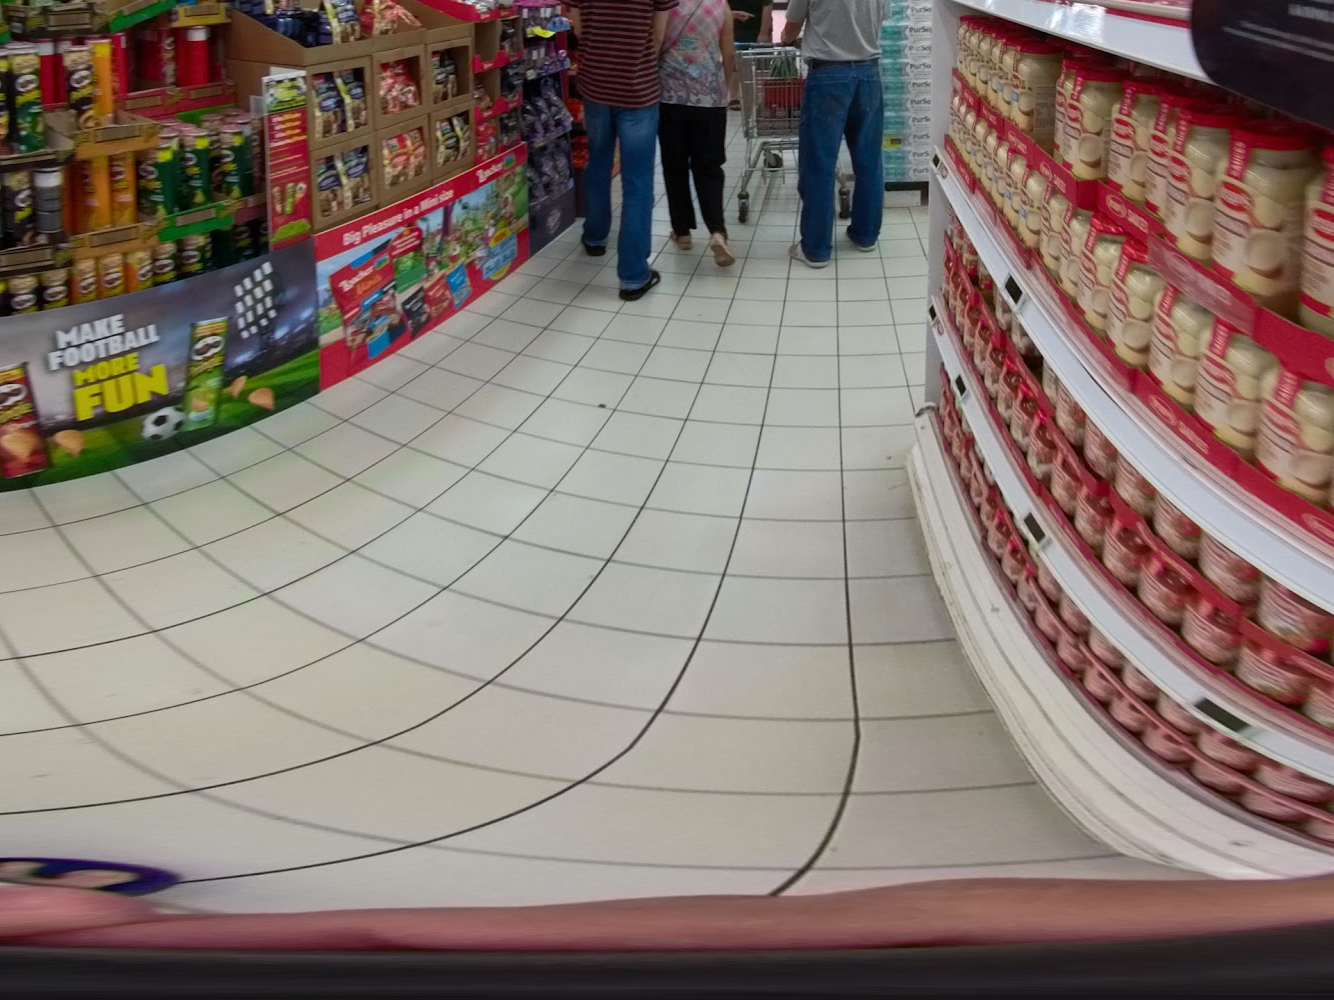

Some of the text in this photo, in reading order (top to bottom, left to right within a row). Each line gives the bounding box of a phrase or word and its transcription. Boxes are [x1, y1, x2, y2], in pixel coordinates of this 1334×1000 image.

[909, 26, 932, 34] PurSo
[342, 230, 362, 246] Big
[362, 213, 403, 237] Pleasure
[403, 208, 413, 220] in
[47, 324, 160, 371] FOOTBALL
[56, 314, 125, 349] MAKE
[73, 352, 139, 386] MORE
[74, 363, 169, 422] FUN
